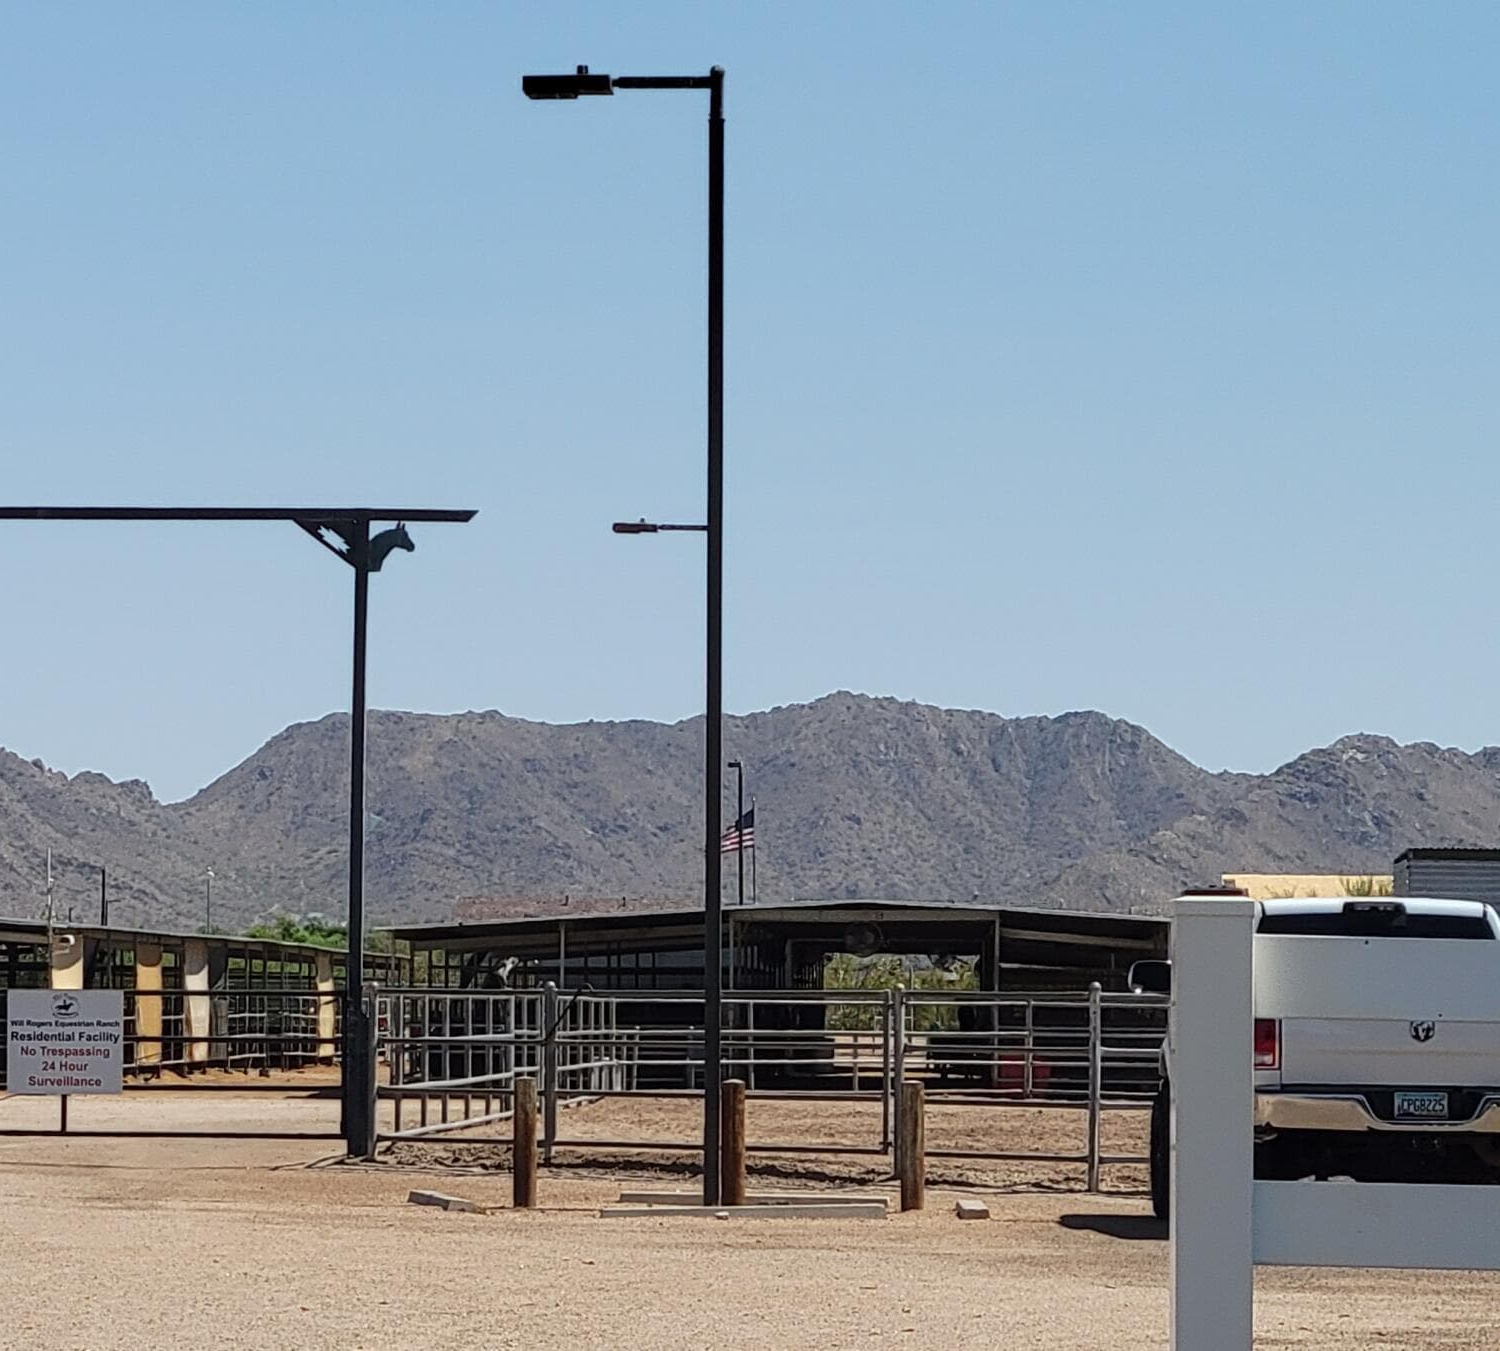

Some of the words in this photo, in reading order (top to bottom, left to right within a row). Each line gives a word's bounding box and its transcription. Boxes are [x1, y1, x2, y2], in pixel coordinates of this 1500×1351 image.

[26, 1020, 52, 1028] Rogers
[54, 1020, 94, 1028] Equestrian
[11, 1031, 75, 1042] Residential
[78, 1032, 120, 1044] Facility
[20, 1046, 36, 1056] No
[40, 1046, 110, 1058] Trespassing
[42, 1061, 56, 1072] 24
[60, 1061, 88, 1072] Hour
[28, 1076, 102, 1086] Surveillance
